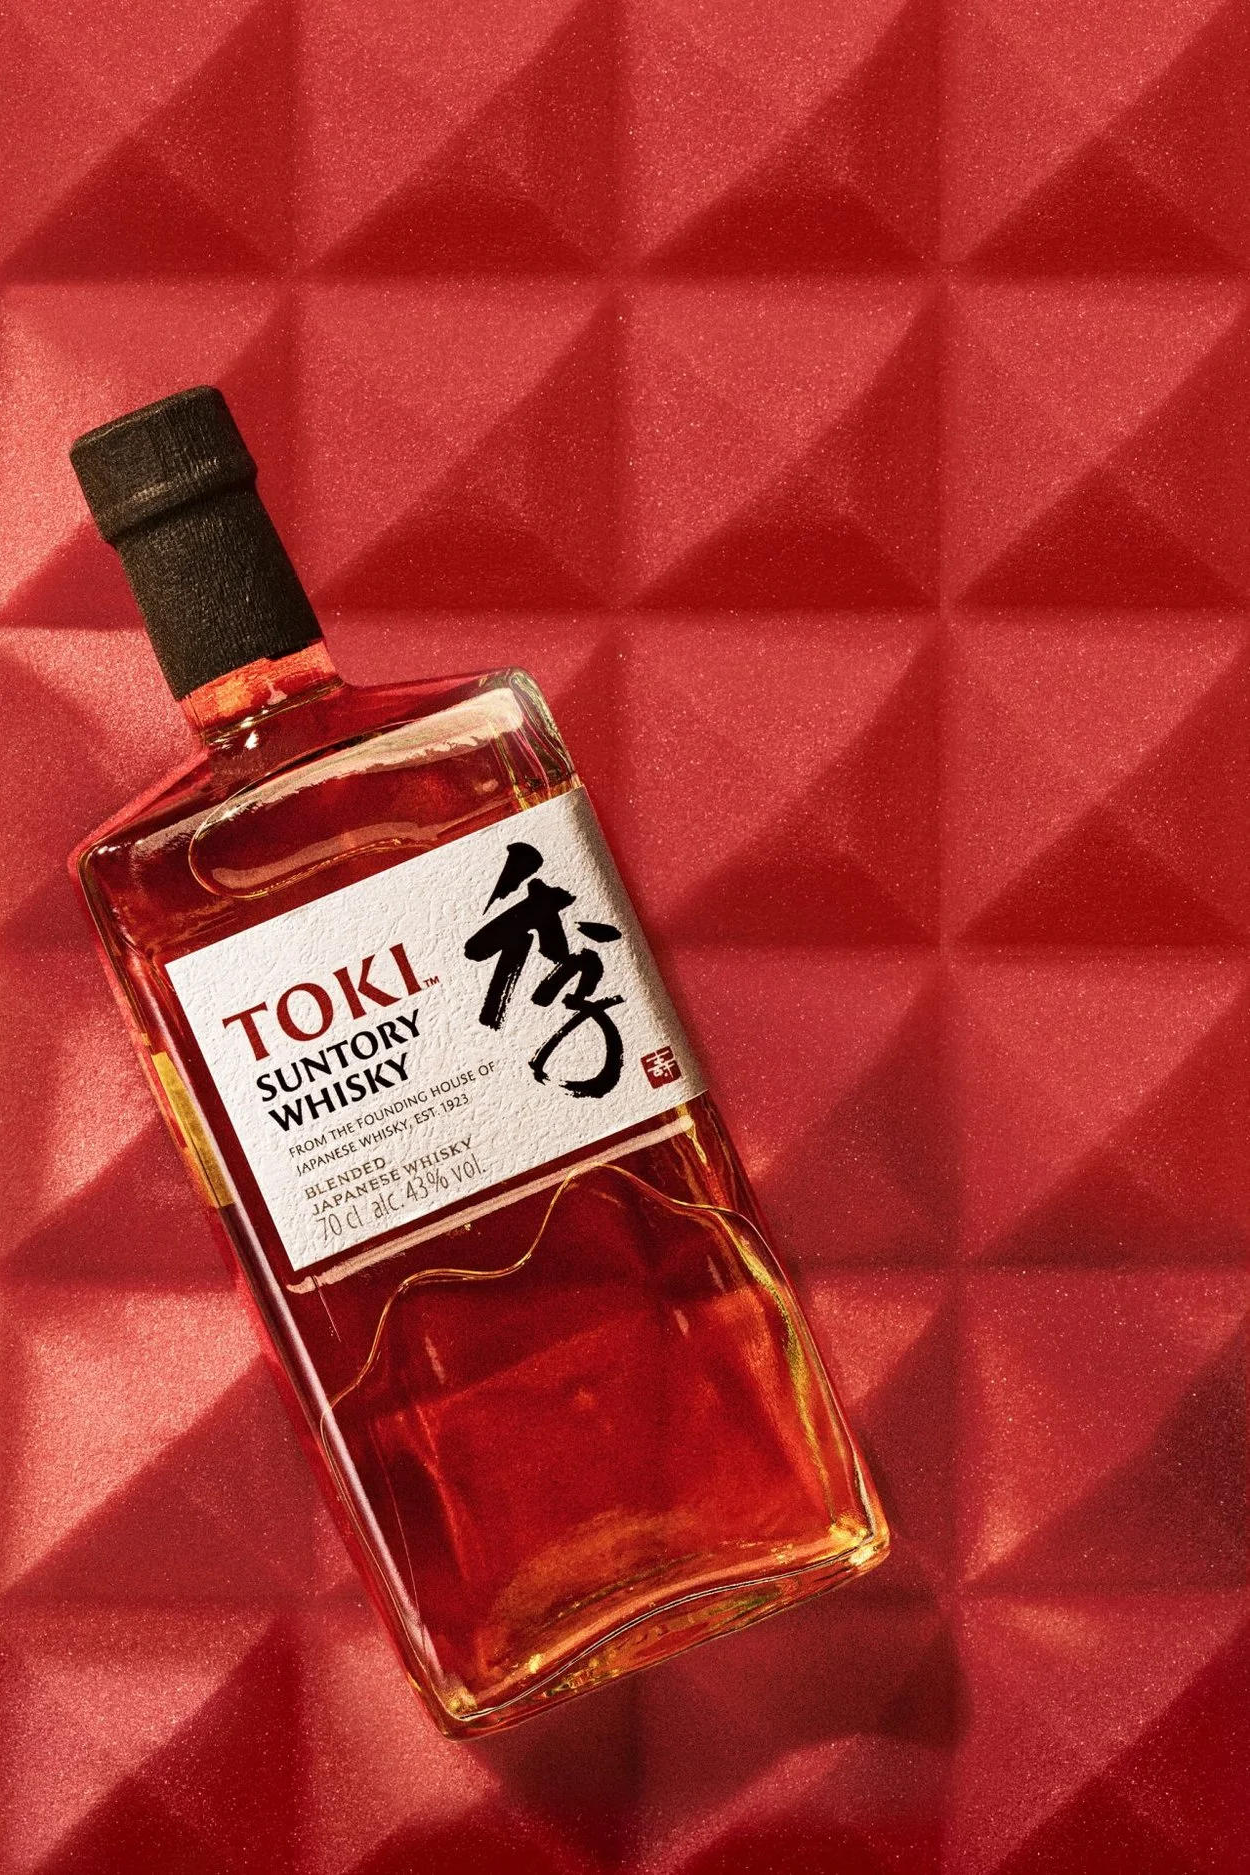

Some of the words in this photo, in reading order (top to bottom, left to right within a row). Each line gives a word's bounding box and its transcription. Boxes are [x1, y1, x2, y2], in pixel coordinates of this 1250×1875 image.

[222, 943, 422, 1061] TOKI
[464, 842, 624, 1099] 季
[256, 1008, 420, 1102] SUNTORY
[268, 1052, 409, 1132] WHISKY
[288, 1134, 328, 1158] FROM
[331, 1122, 356, 1142] THE
[357, 1091, 428, 1130] FOUNDING
[430, 1070, 476, 1098] HOUSE
[478, 1061, 496, 1077] OF
[296, 1141, 357, 1177] JAPANESE
[359, 1118, 414, 1149] WHISKY,
[414, 1107, 440, 1125] EST.
[440, 1093, 469, 1112] 1923
[304, 1157, 387, 1200] BLENDED
[312, 1169, 401, 1216] JAPANESE
[403, 1136, 473, 1176] WHISKY
[316, 1213, 343, 1241] 70
[346, 1204, 364, 1230] cl
[371, 1192, 405, 1219] alc.
[406, 1168, 449, 1201] 43%
[451, 1153, 487, 1183] vol.
